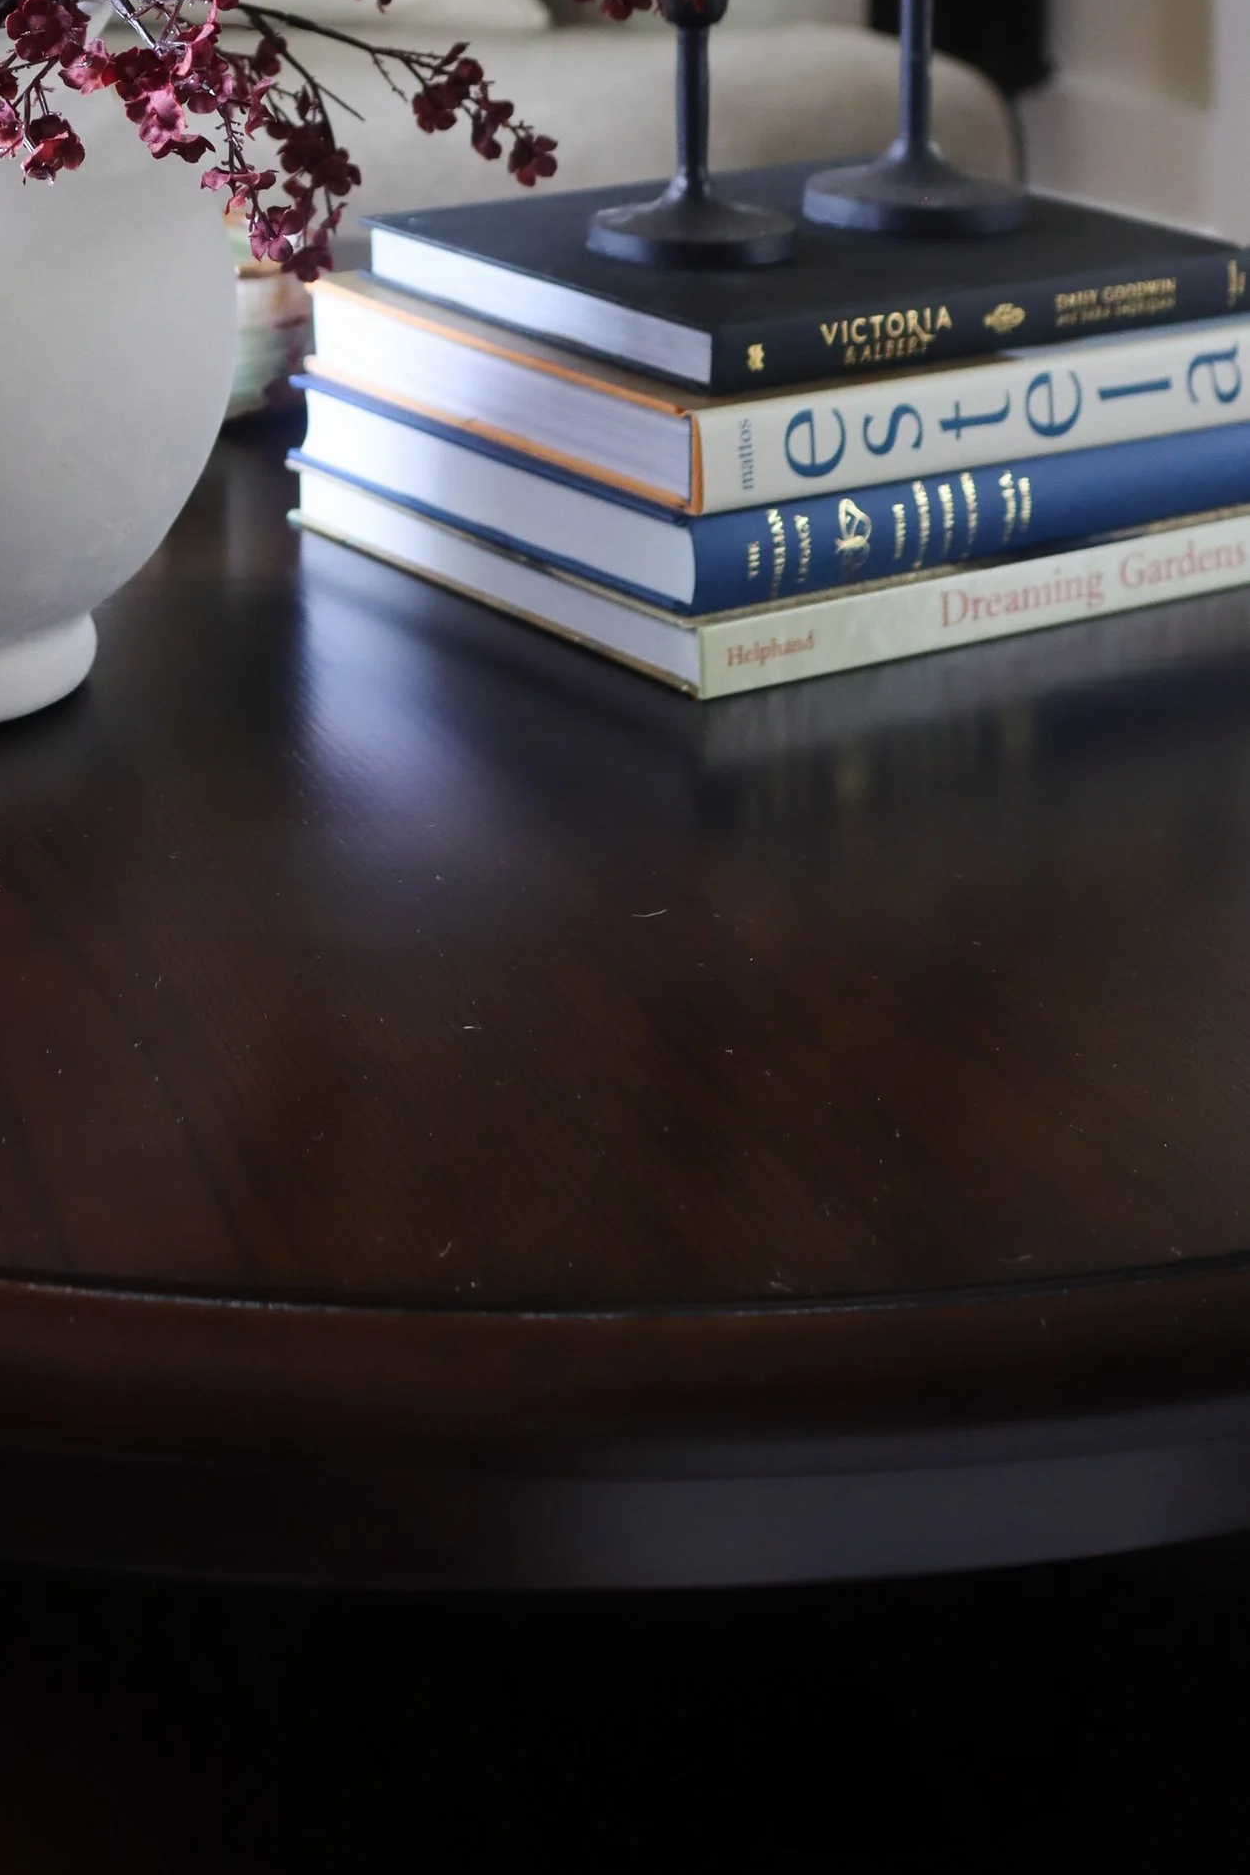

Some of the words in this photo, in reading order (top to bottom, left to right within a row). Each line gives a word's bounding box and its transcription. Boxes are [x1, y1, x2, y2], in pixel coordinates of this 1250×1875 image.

[819, 305, 953, 346] VICTORIA
[784, 340, 1242, 480] estela
[747, 540, 761, 580] THE
[939, 566, 1105, 628] Dreaming
[1118, 539, 1247, 589] Gardens
[726, 630, 814, 667] Helphand
